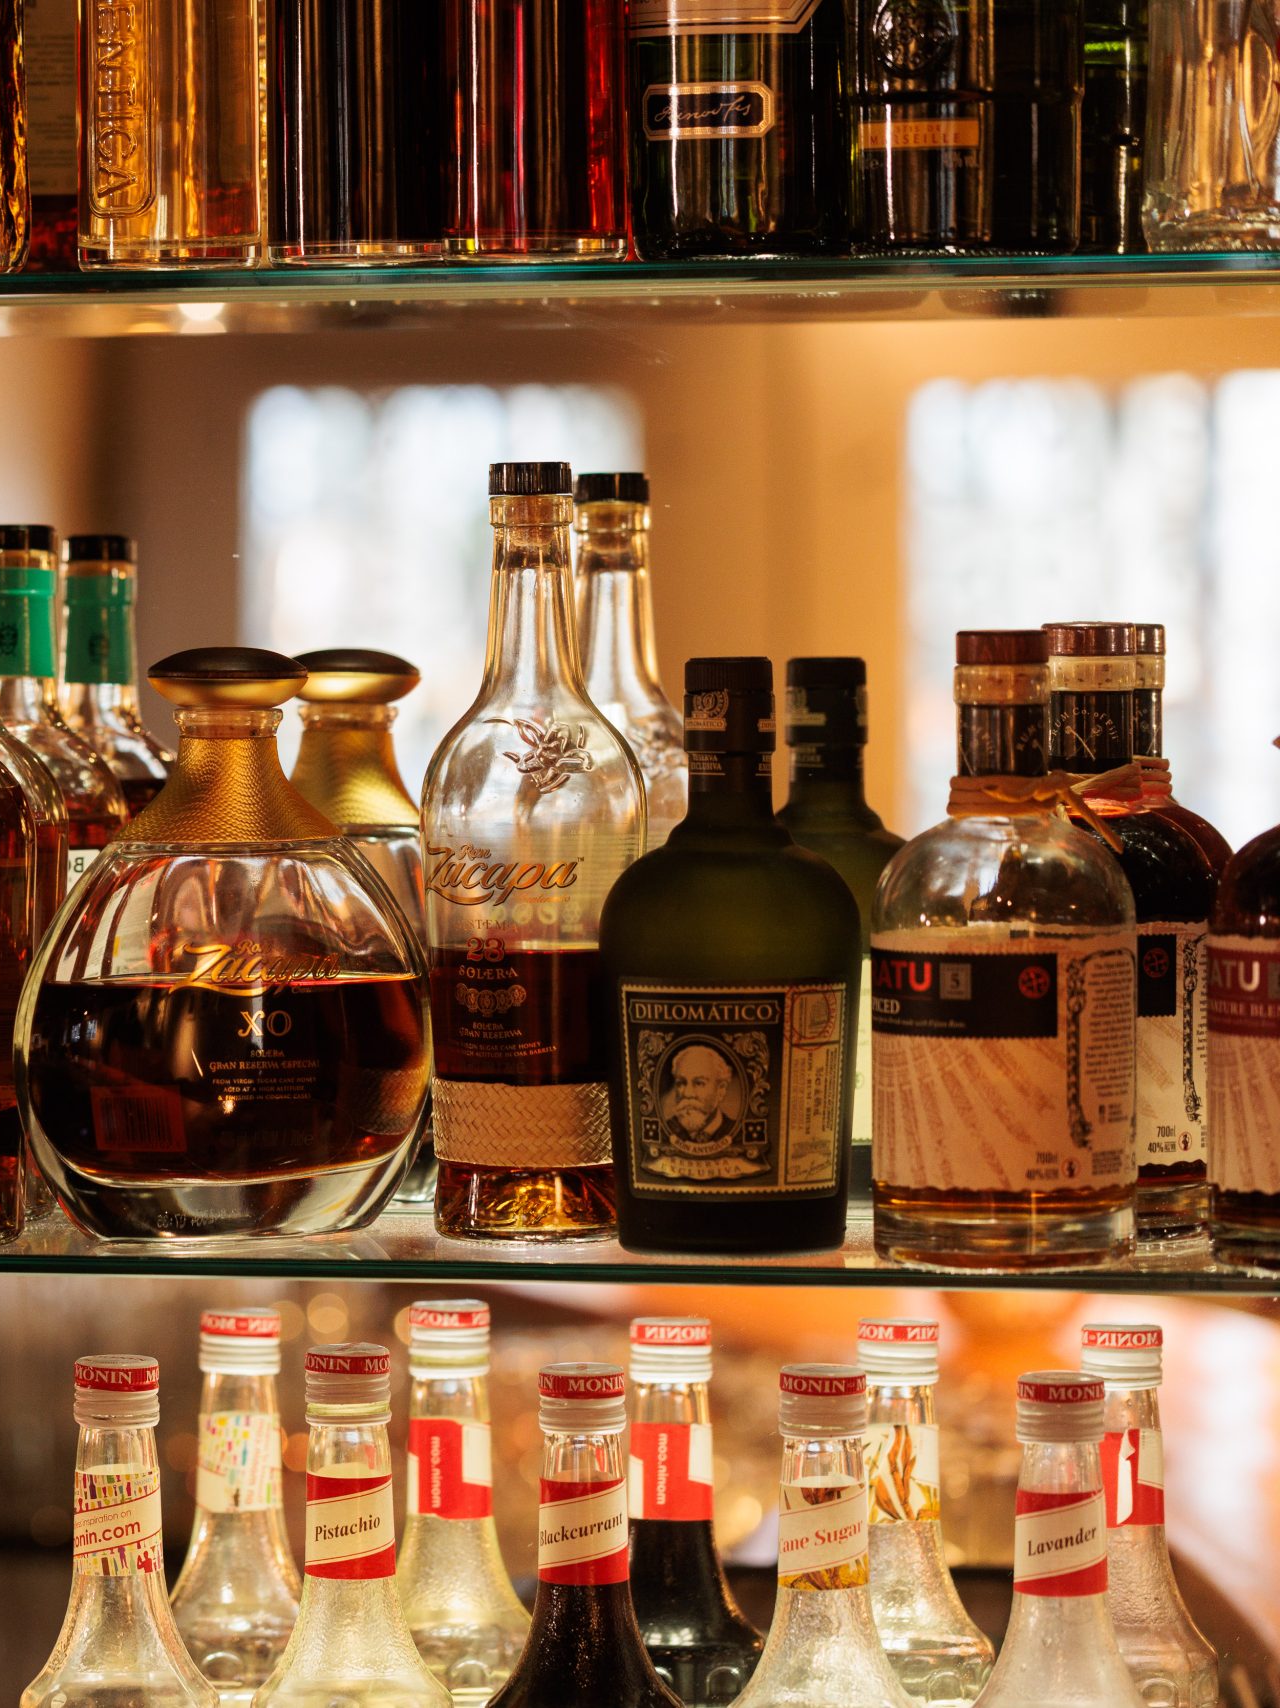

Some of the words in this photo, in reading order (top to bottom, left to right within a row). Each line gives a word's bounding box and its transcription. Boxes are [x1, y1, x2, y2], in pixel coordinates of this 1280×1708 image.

[96, 3, 138, 199] ENTICA
[870, 133, 962, 145] MRSEILLE
[425, 841, 578, 907] Zacapa
[466, 937, 506, 963] 23
[458, 965, 520, 980] SOLERA
[949, 973, 960, 988] 5
[1210, 960, 1260, 992] ATU
[237, 1009, 292, 1037] XO
[634, 1001, 773, 1021] DIPLOMÁTICO
[209, 1061, 237, 1073] GRAN
[239, 1060, 279, 1071] RESERVA
[1148, 1142, 1164, 1153] 40%
[782, 1376, 846, 1393] MONIN
[81, 1514, 120, 1528] inspiration
[121, 1509, 133, 1518] on
[313, 1516, 381, 1543] Pistachio
[538, 1512, 623, 1547] Blackcurrant
[780, 1532, 810, 1554] ane
[814, 1519, 864, 1547] Sugar
[1027, 1526, 1097, 1557] Lavander
